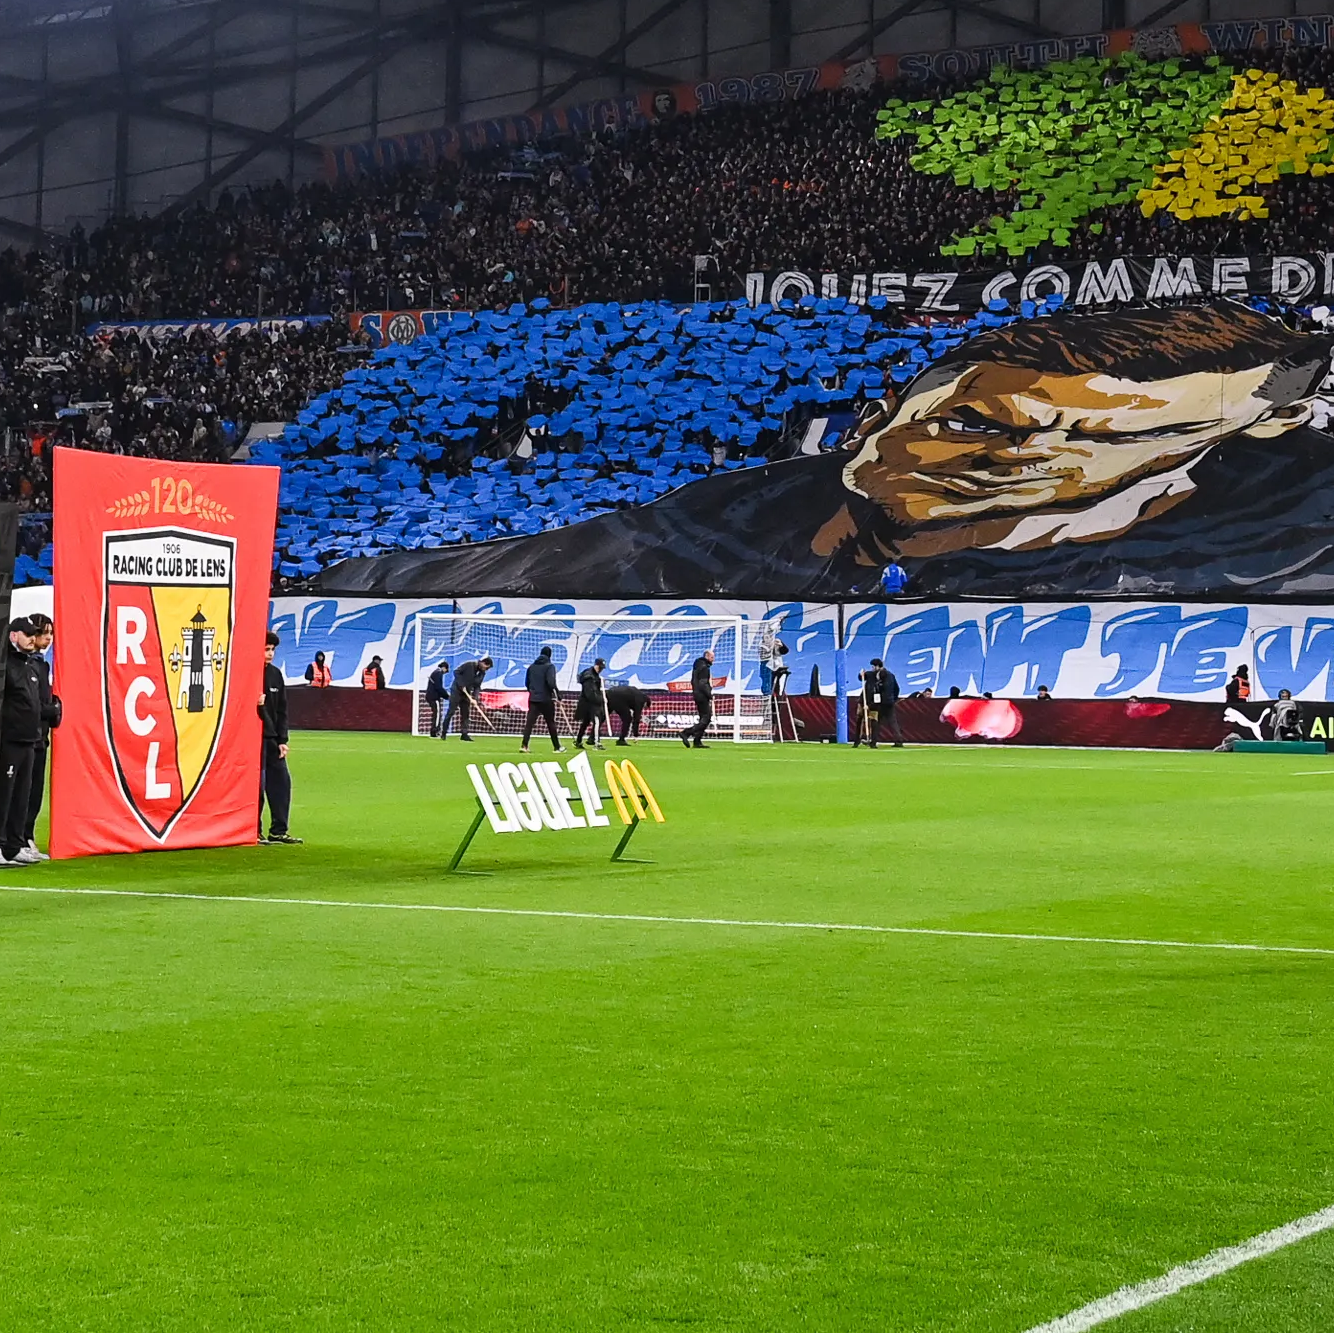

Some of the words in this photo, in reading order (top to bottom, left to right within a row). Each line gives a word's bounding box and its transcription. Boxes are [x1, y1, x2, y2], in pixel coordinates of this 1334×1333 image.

[898, 34, 1109, 80] SOUTH
[695, 68, 819, 112] 1987
[981, 256, 1250, 311] COMME
[151, 476, 193, 515] 120
[113, 554, 153, 577] RACING
[155, 556, 183, 577] CLUB
[185, 558, 198, 577] DE
[200, 558, 226, 578] LENS
[162, 543, 181, 555] 1906
[1094, 605, 1249, 698] JE
[466, 761, 588, 834] LIGUE
